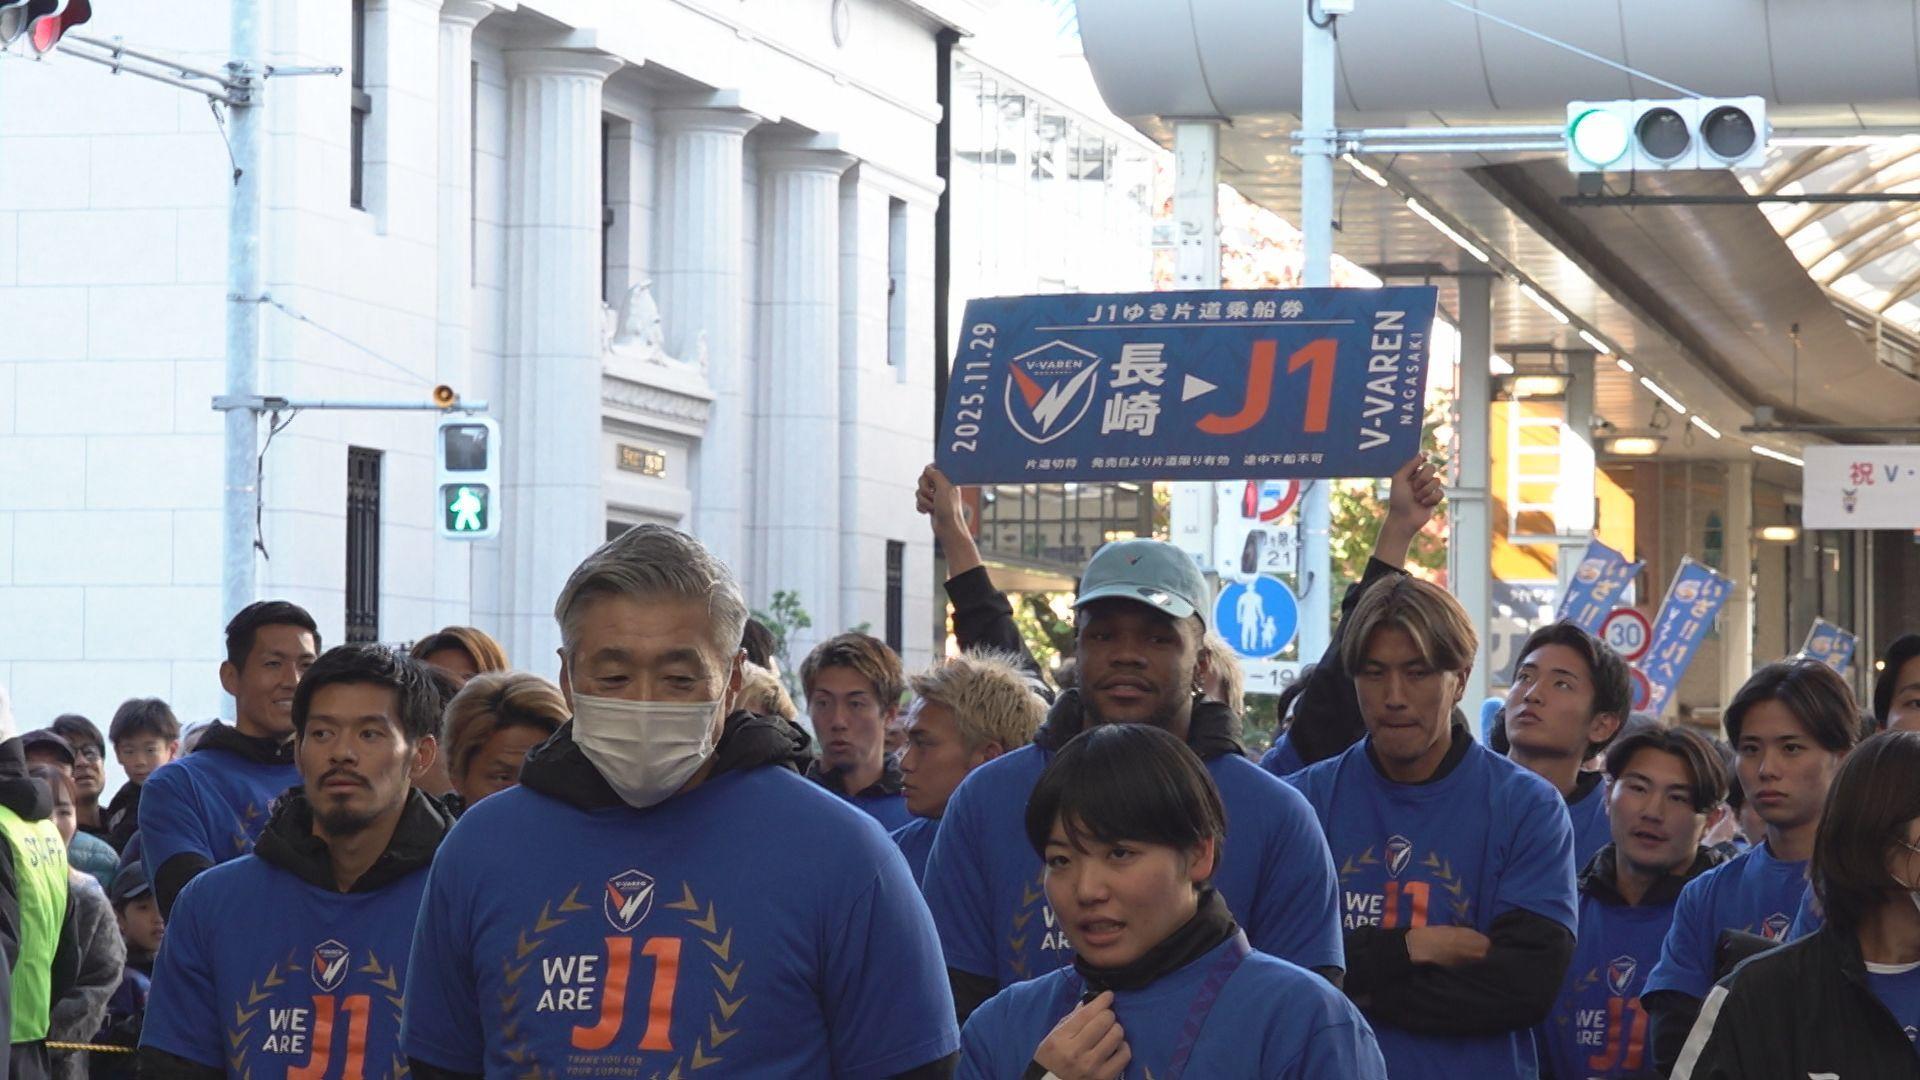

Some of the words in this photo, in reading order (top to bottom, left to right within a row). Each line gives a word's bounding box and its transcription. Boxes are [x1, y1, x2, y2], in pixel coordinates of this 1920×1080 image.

[1087, 300, 1304, 323] J1ゆき片道乗船券
[951, 322, 996, 452] 2025.11.29
[1102, 342, 1168, 437] 長崎
[1195, 339, 1338, 435] J1
[1358, 310, 1406, 451] V-VAREN
[1400, 332, 1423, 425] NAGASAKI
[1611, 623, 1641, 647] 30
[1344, 891, 1385, 914] WE
[541, 954, 599, 985] WE
[570, 936, 682, 1051] J1
[268, 1007, 309, 1033] WE
[535, 986, 595, 1013] ARE
[1575, 1008, 1607, 1029] WE
[261, 1034, 306, 1055] ARE
[286, 994, 372, 1080] J1
[1588, 996, 1649, 1072] J1
